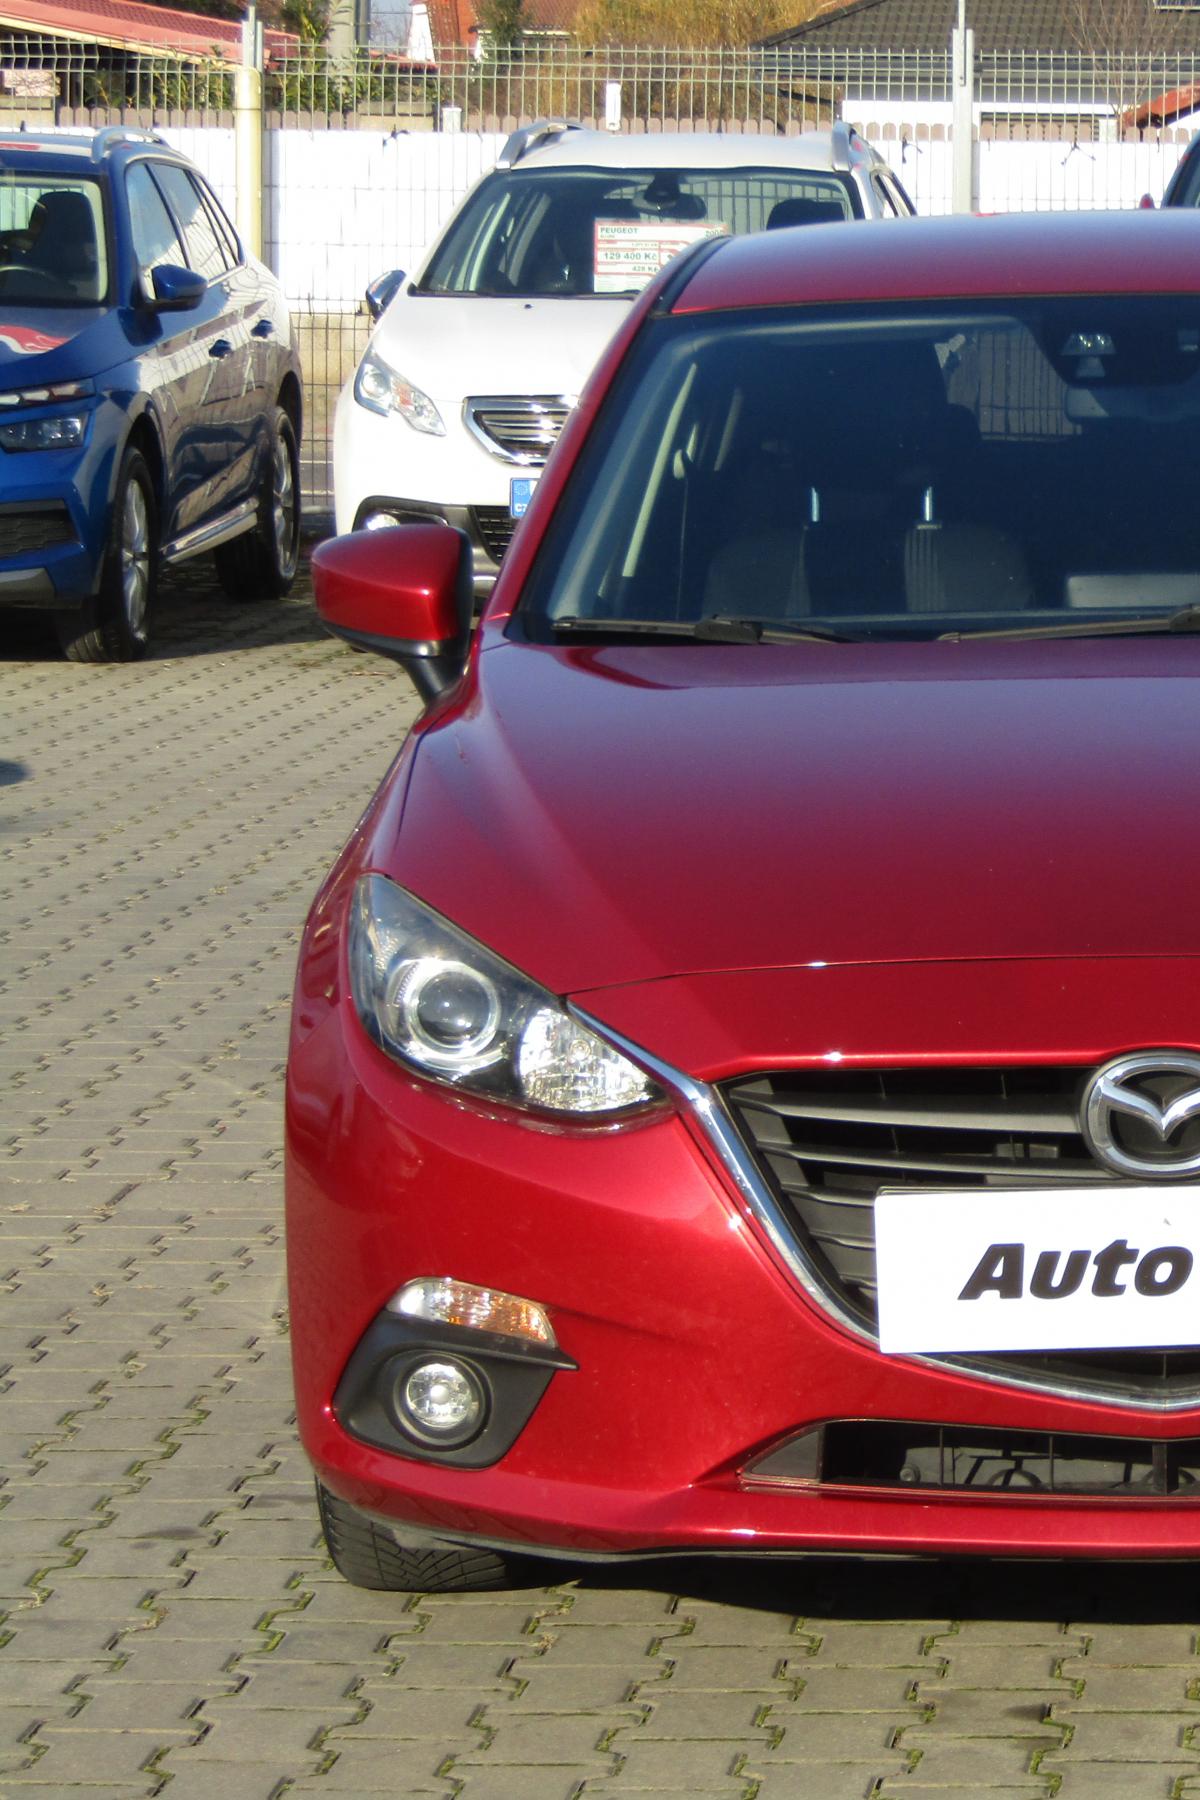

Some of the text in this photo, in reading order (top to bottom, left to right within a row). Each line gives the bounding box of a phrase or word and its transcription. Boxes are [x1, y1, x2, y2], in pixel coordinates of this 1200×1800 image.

[604, 251, 657, 260] 129 400 Kč
[957, 1239, 1194, 1301] Auto
